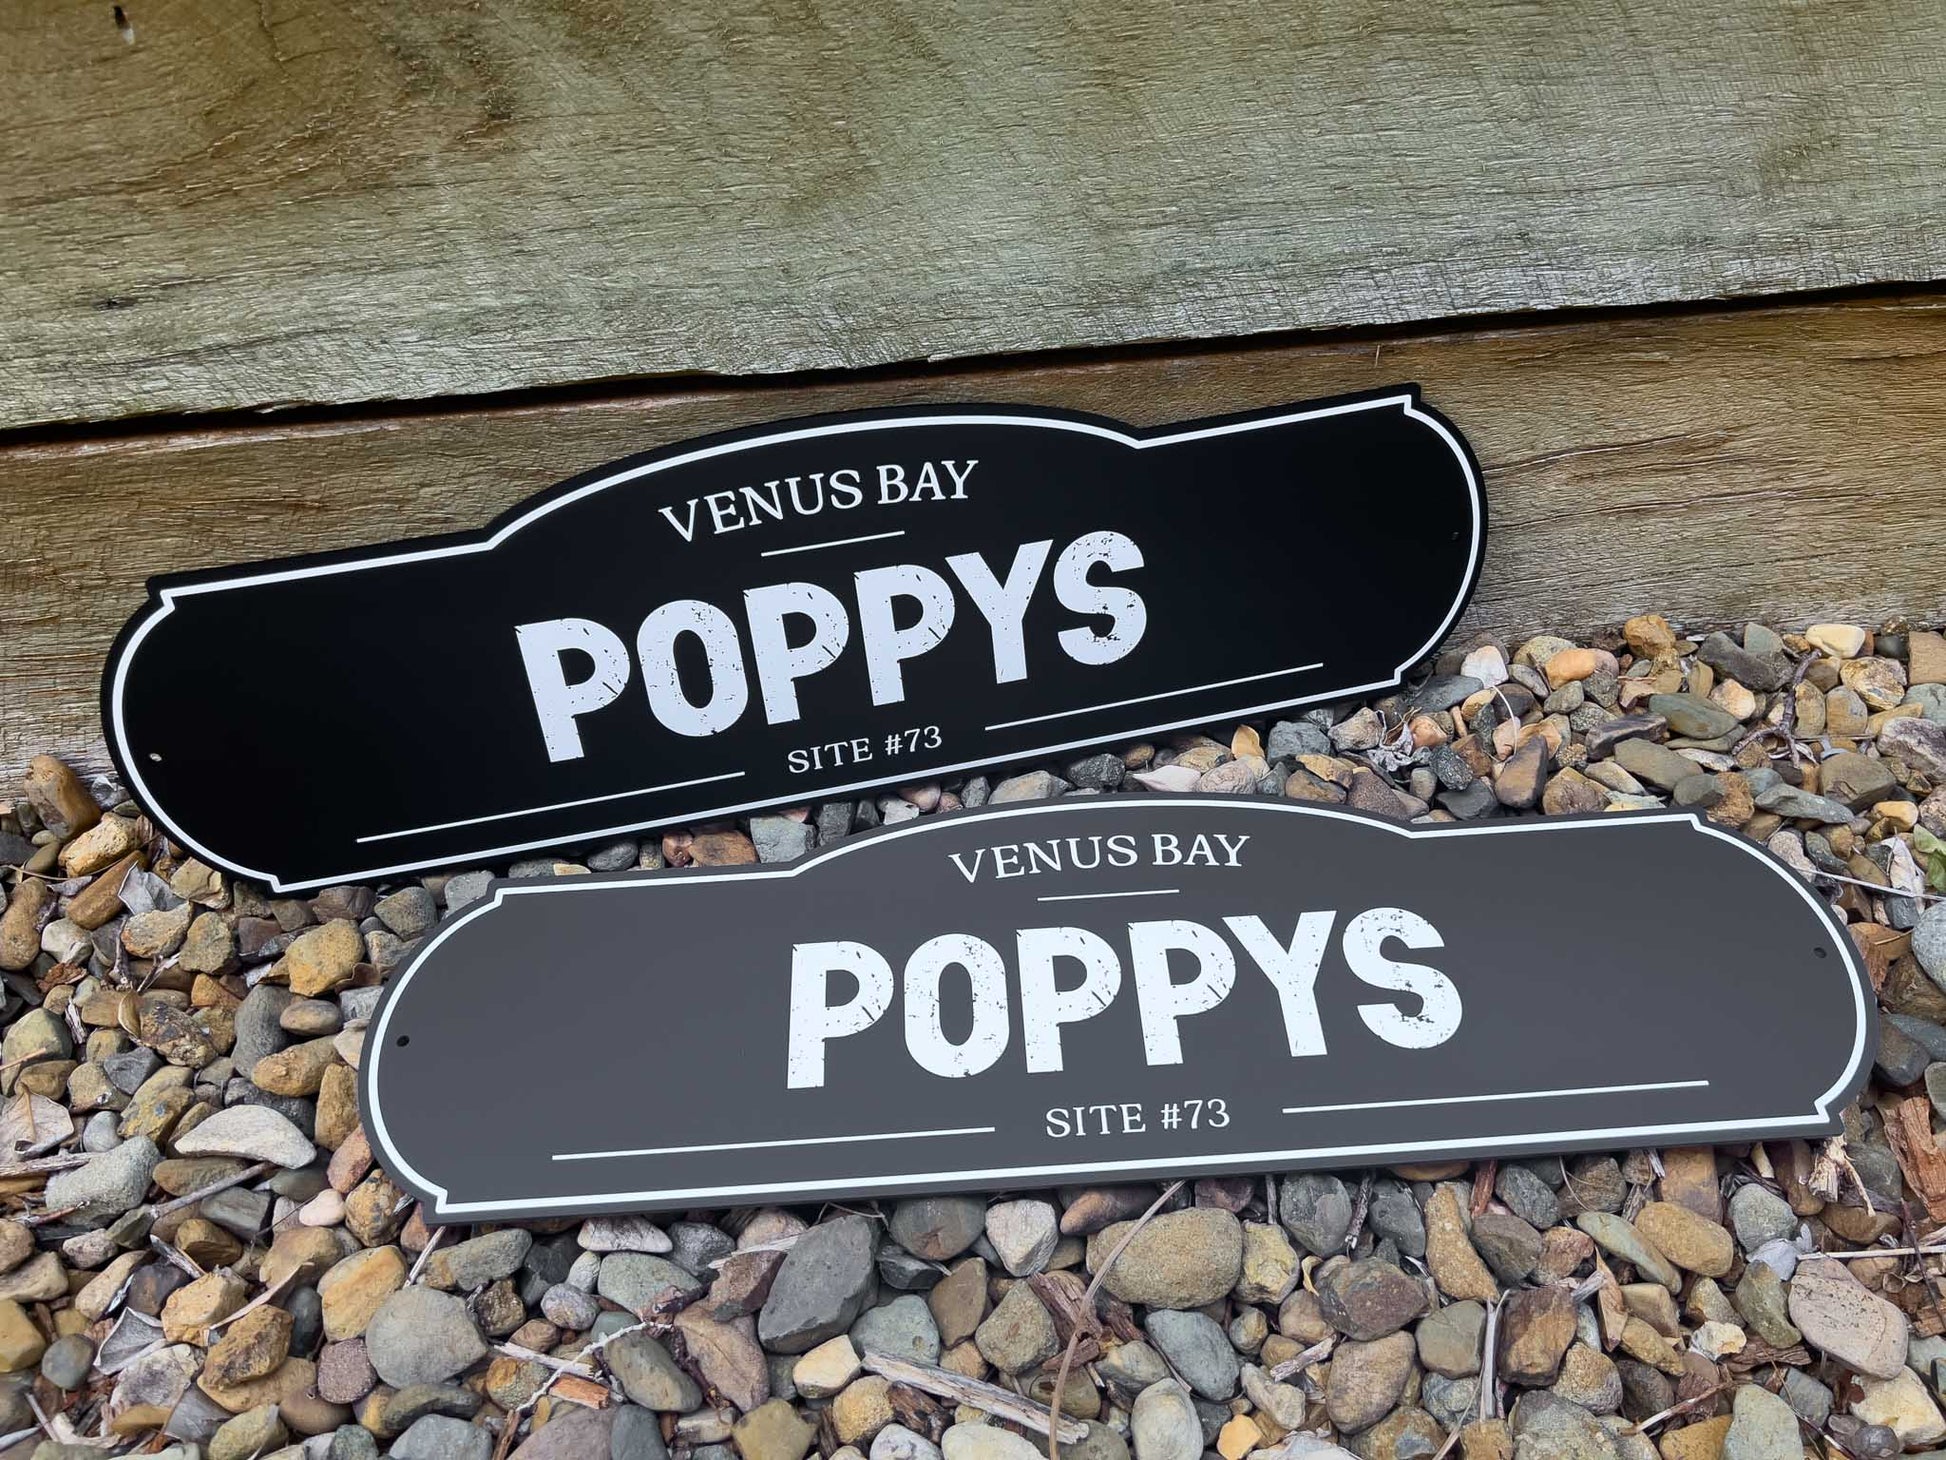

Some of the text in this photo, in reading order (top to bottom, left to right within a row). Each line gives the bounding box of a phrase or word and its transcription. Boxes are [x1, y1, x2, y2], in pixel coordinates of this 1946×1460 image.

[658, 459, 979, 542] VENUS BAY
[515, 531, 1147, 763] POPPYS
[787, 725, 943, 774] SITE #73
[948, 833, 1251, 883] VENUS BAY
[787, 907, 1463, 1090] POPPYS
[1045, 1098, 1230, 1138] SITE #73
